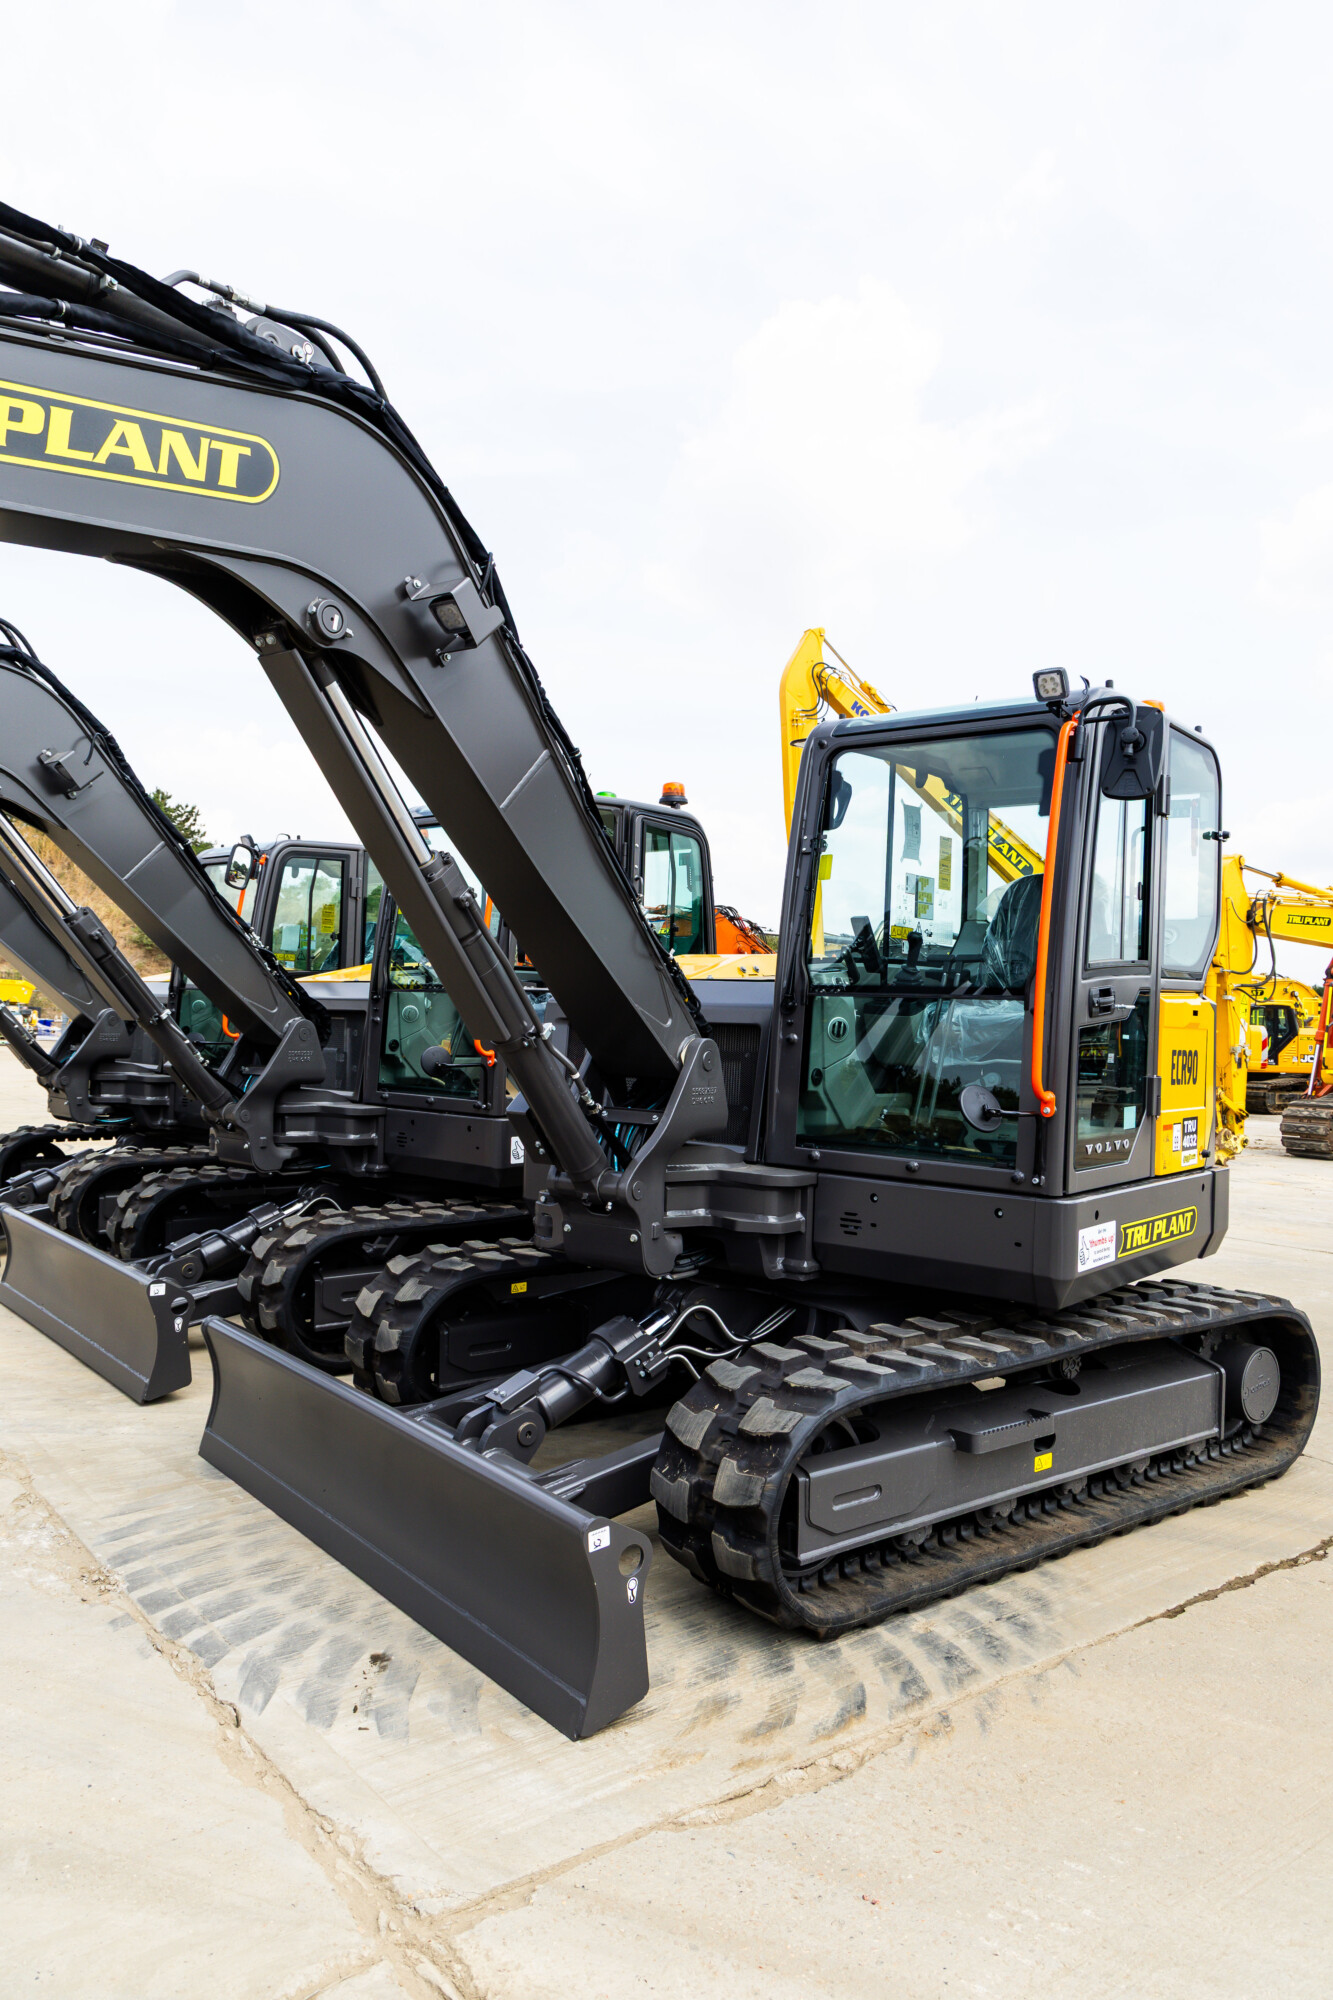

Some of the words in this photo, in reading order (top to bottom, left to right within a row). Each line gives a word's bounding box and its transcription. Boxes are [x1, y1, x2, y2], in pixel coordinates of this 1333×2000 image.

[0, 394, 252, 488] PLANT
[1304, 916, 1330, 926] PLANT
[1171, 1049, 1199, 1085] ECR90
[1183, 1119, 1197, 1133] TRU
[1085, 1138, 1130, 1155] VOLVO
[1182, 1134, 1197, 1148] 4032
[1125, 1222, 1152, 1249] TRU
[1152, 1211, 1193, 1241] PLANT
